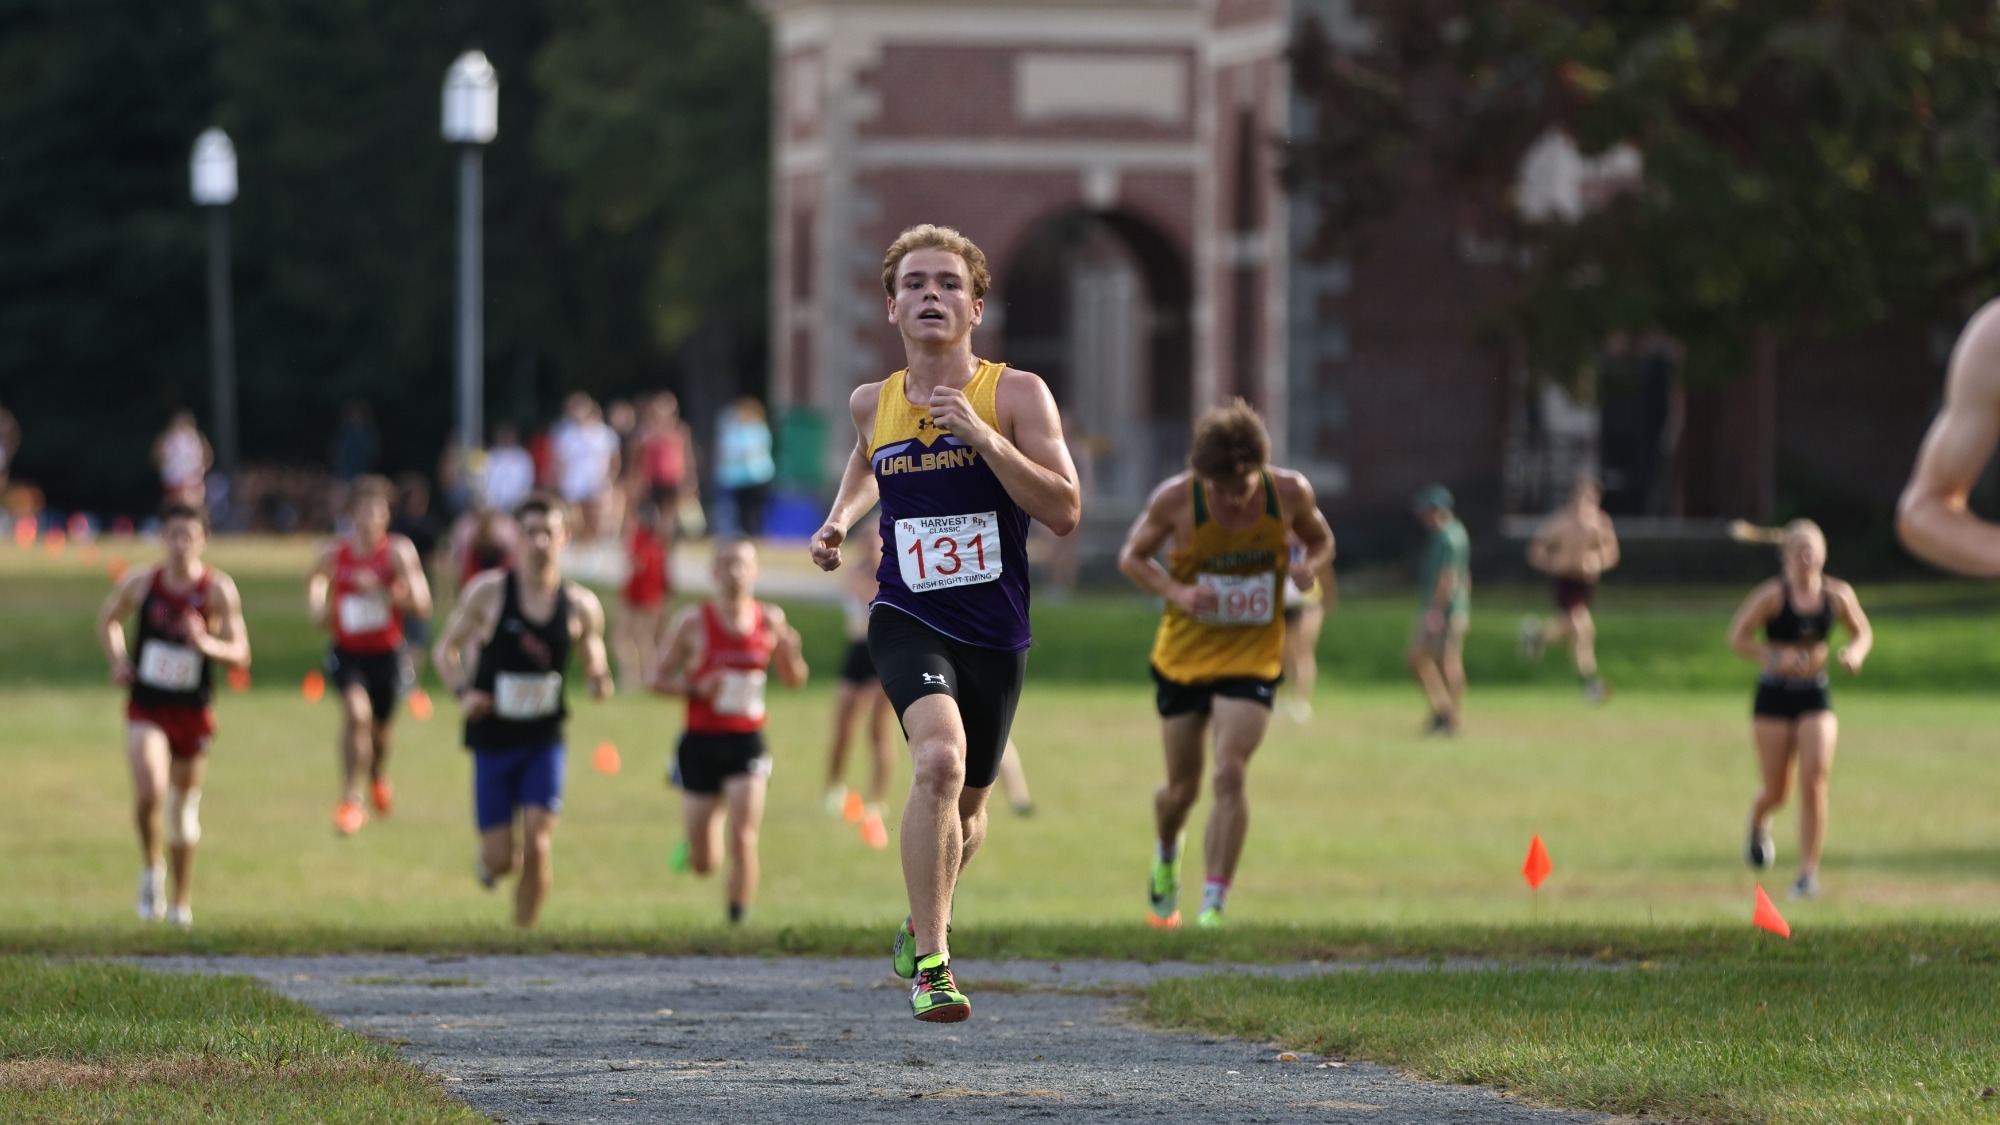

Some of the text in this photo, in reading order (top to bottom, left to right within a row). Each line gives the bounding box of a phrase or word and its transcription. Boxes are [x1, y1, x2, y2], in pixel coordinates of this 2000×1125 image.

[881, 447, 978, 476] UALBANY
[903, 522, 916, 535] RPI
[921, 516, 968, 528] HARVEST
[972, 516, 986, 528] RPI
[929, 526, 961, 534] CLASSIC
[908, 533, 986, 579] 131
[912, 572, 992, 590] FINISH RIGHT TIMING
